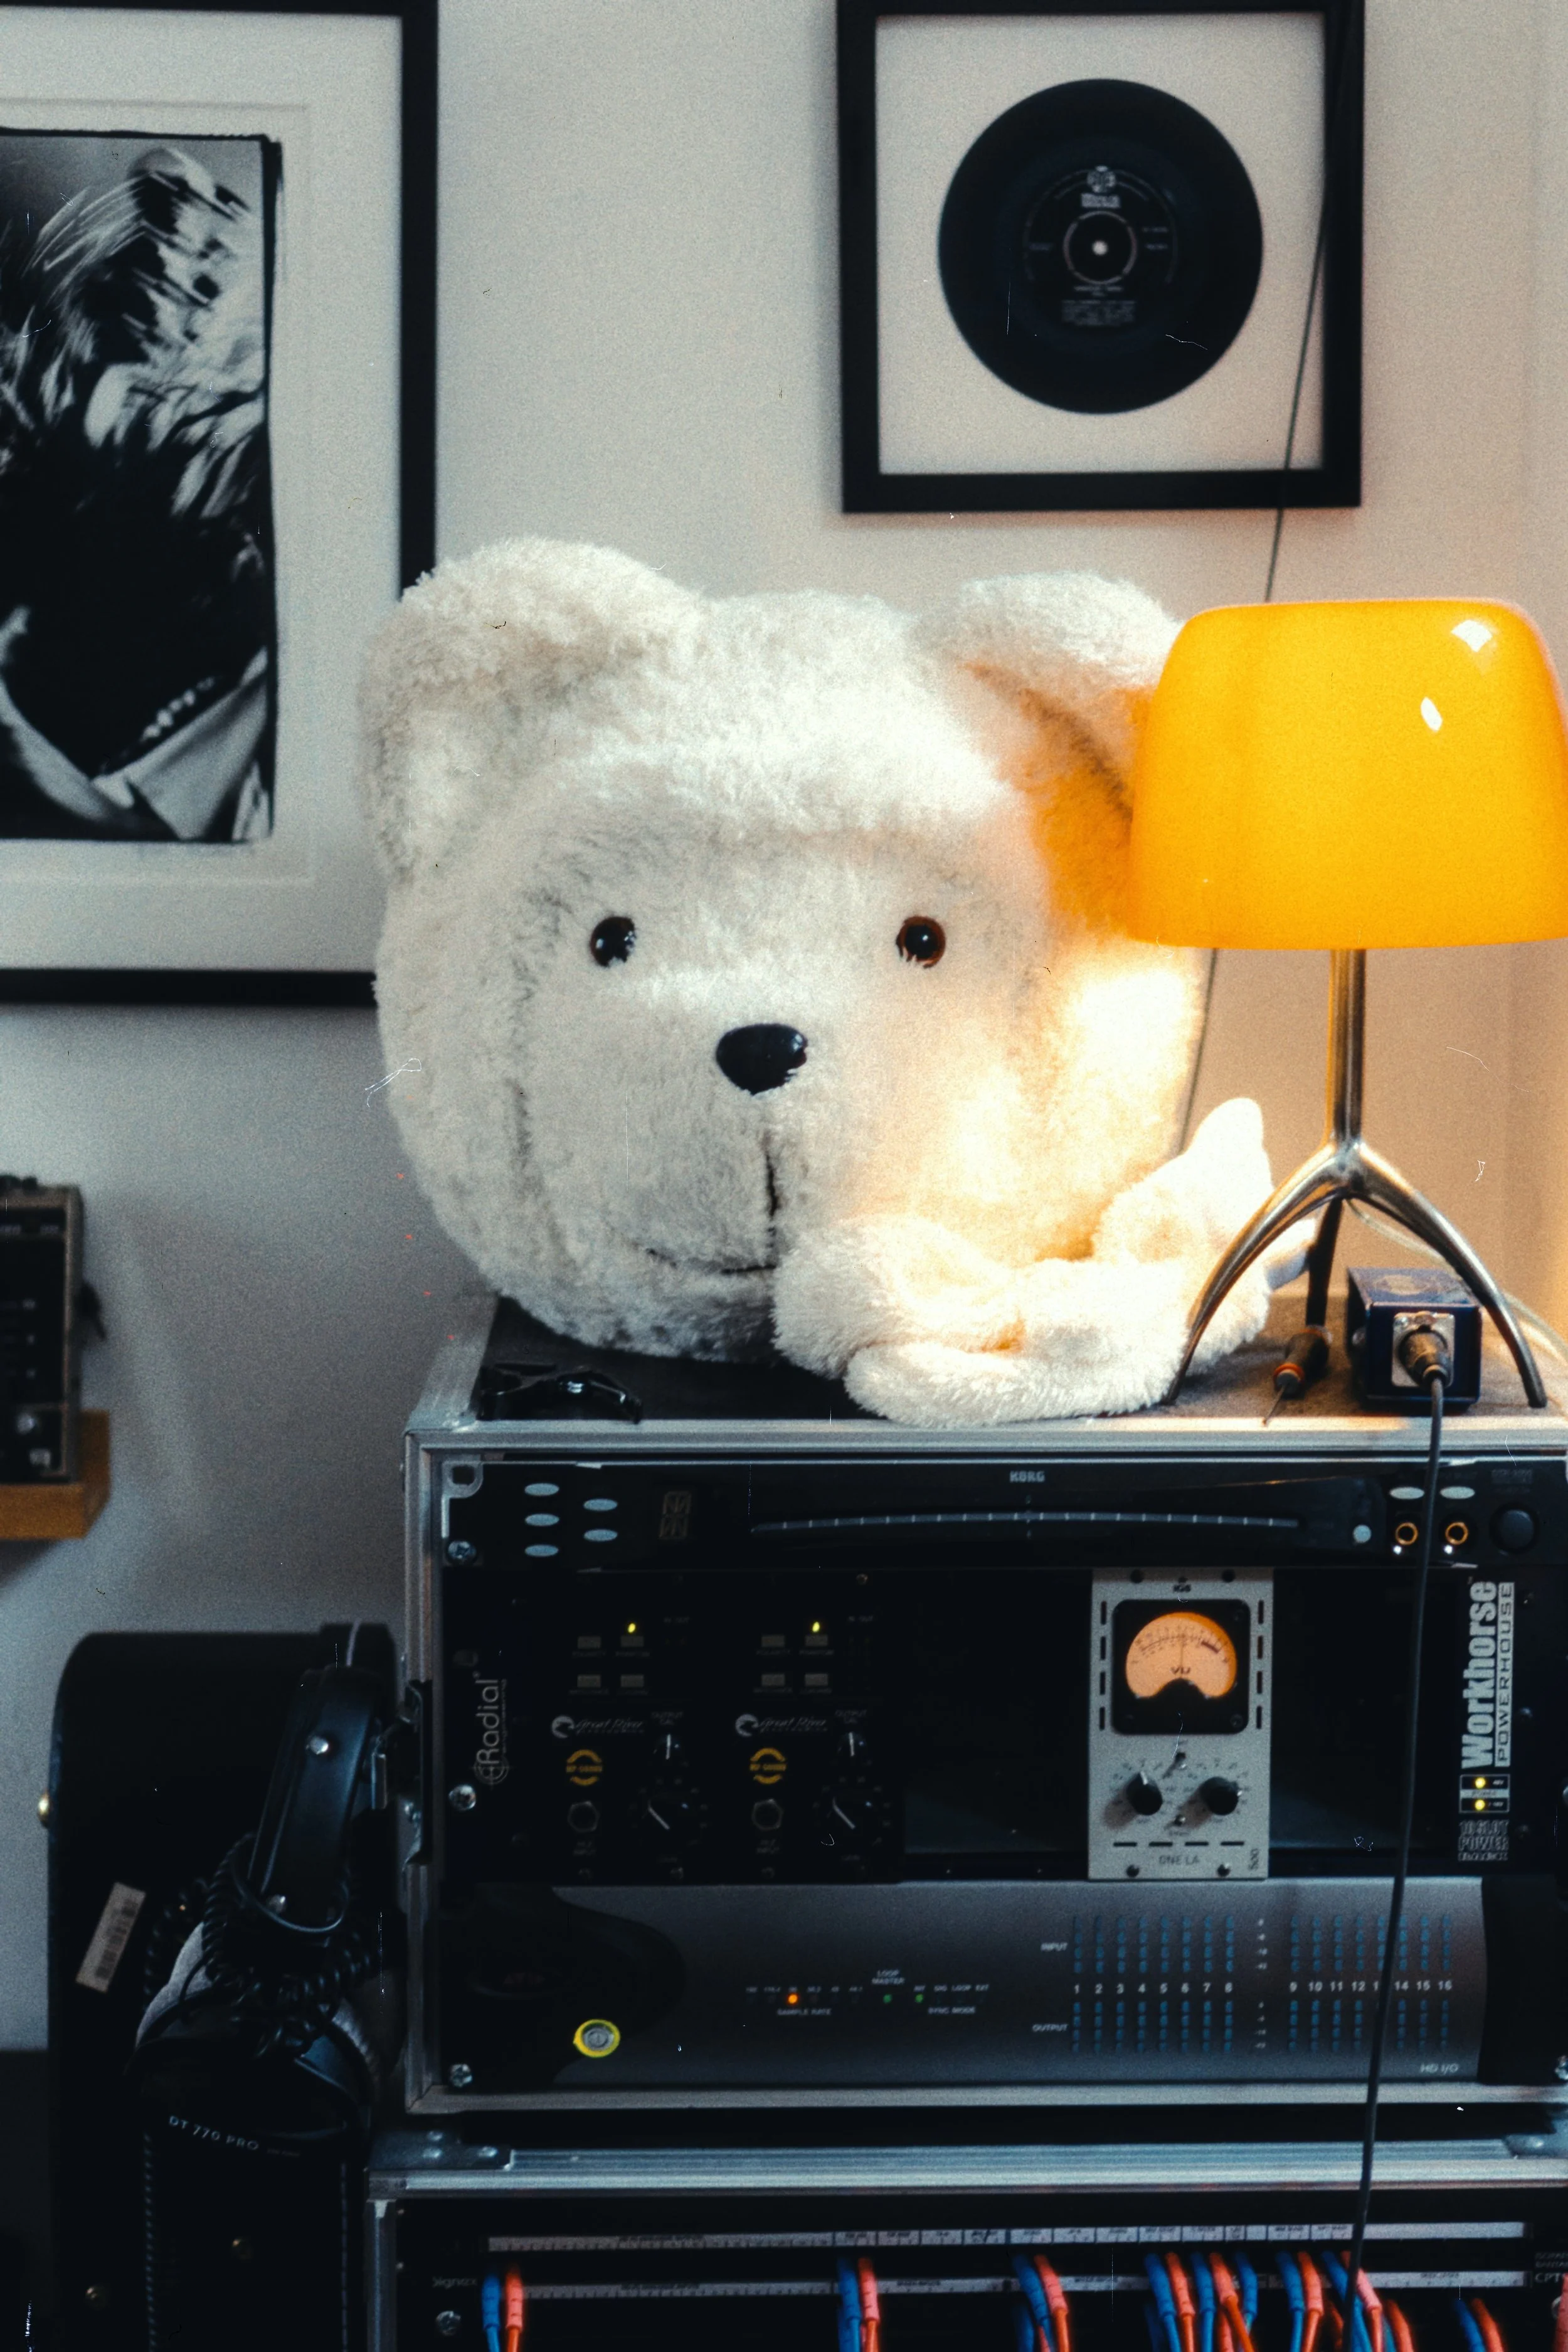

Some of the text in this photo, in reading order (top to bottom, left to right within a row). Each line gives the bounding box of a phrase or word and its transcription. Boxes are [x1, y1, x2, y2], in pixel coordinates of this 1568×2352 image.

[1010, 1470, 1045, 1483] KORG
[1461, 1581, 1497, 1769] Workhorse
[1497, 1584, 1512, 1762] POWERHOUSE
[1041, 1942, 1068, 1952] INPUT
[1074, 1983, 1080, 1994] 1
[1095, 1983, 1103, 1994] 2
[1116, 1983, 1125, 1994] 3
[1138, 1983, 1147, 1994] 4
[1202, 1982, 1211, 1993] 7
[1330, 1980, 1343, 1992] 11
[1351, 1980, 1365, 1992] 12
[1394, 1980, 1409, 1991] 14
[169, 2114, 260, 2151] DT 770 PRO
